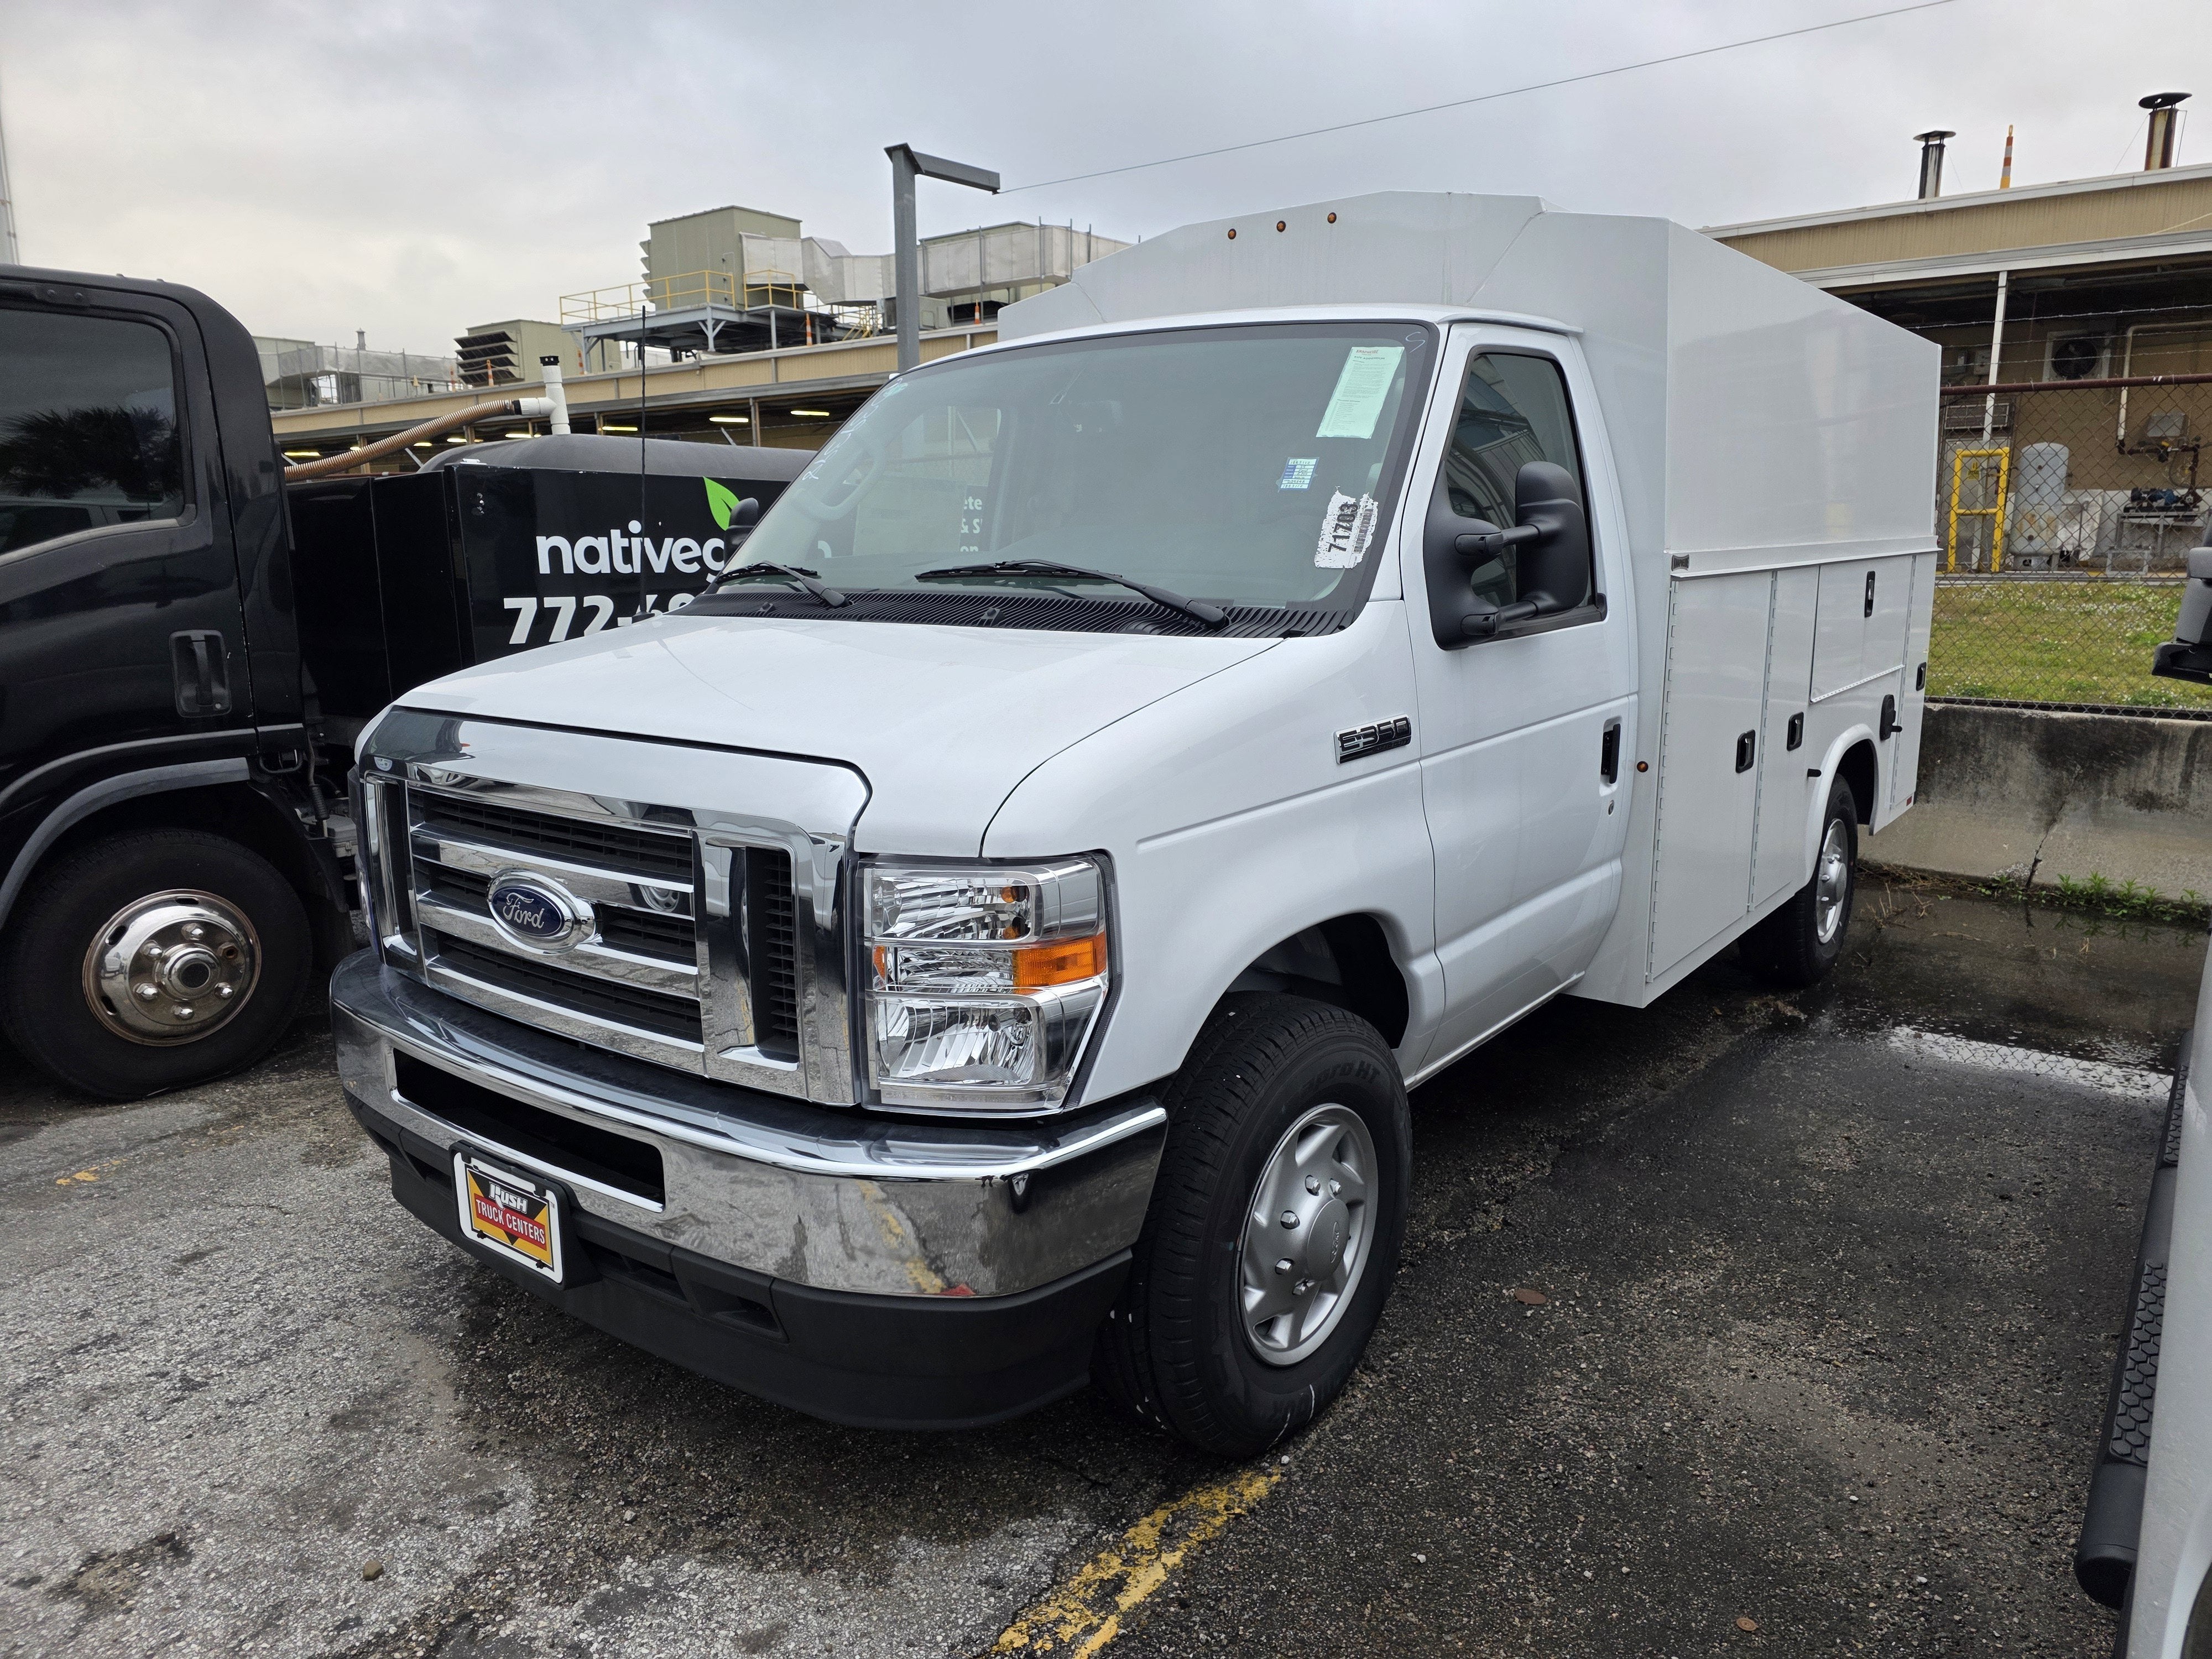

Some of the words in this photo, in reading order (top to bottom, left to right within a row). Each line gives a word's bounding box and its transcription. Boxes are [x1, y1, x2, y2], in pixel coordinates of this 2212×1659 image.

[502, 892, 545, 929] Ford
[489, 1181, 528, 1214] RUSH
[476, 1199, 504, 1225] TRUCK
[506, 1213, 545, 1244] CENTERS
